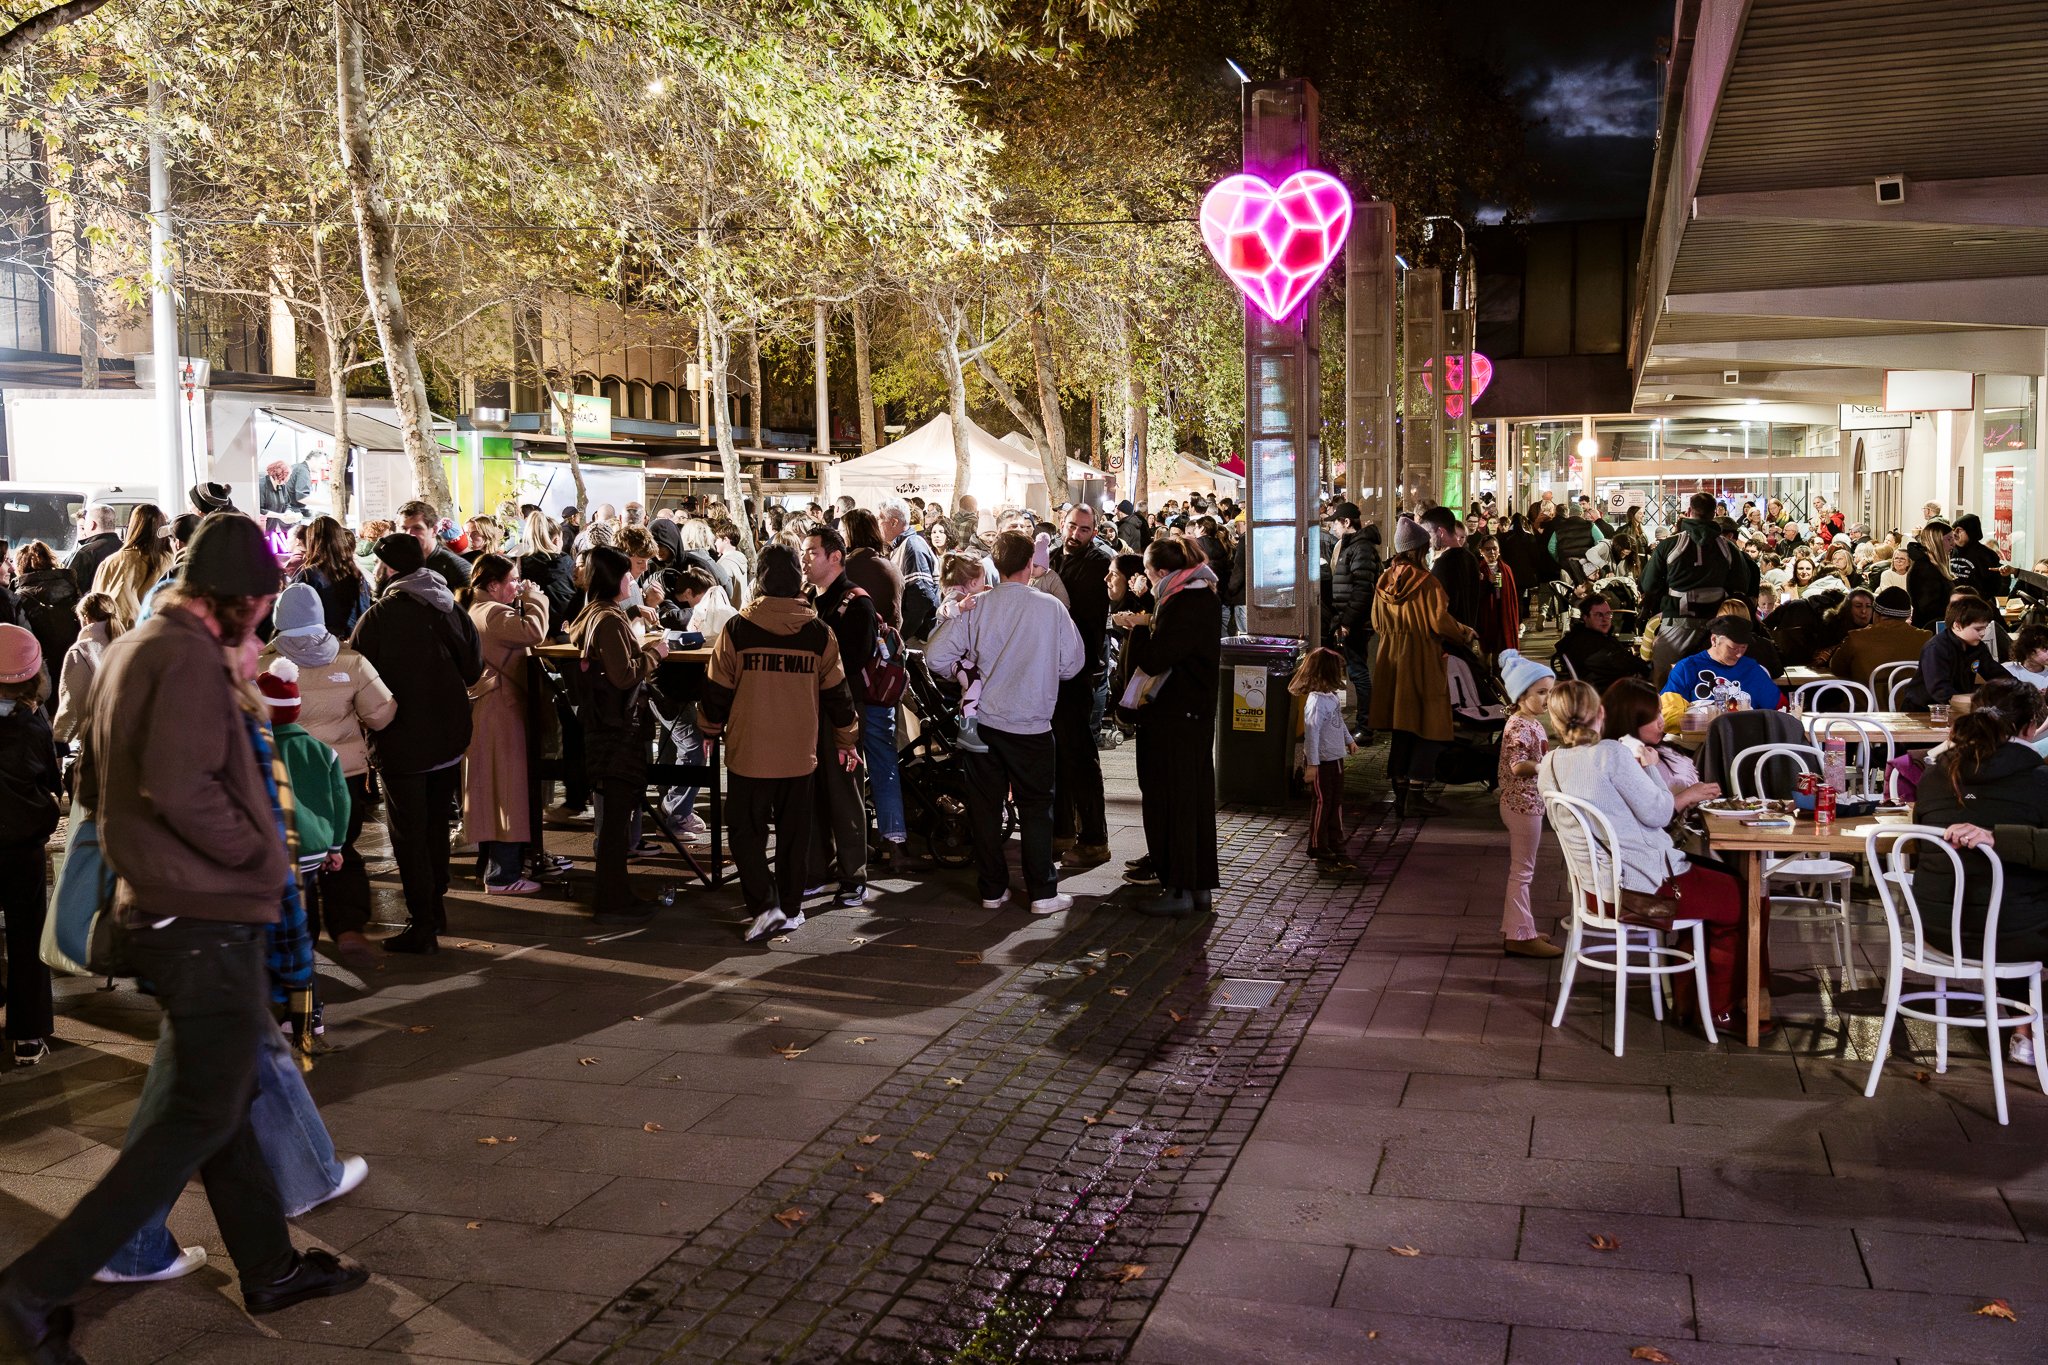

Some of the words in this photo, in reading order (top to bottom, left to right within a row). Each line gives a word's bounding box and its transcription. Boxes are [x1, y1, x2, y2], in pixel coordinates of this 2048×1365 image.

[573, 412, 598, 423] AMAICA
[1112, 456, 1121, 465] 20
[761, 654, 783, 672] THE
[783, 655, 815, 673] WALL
